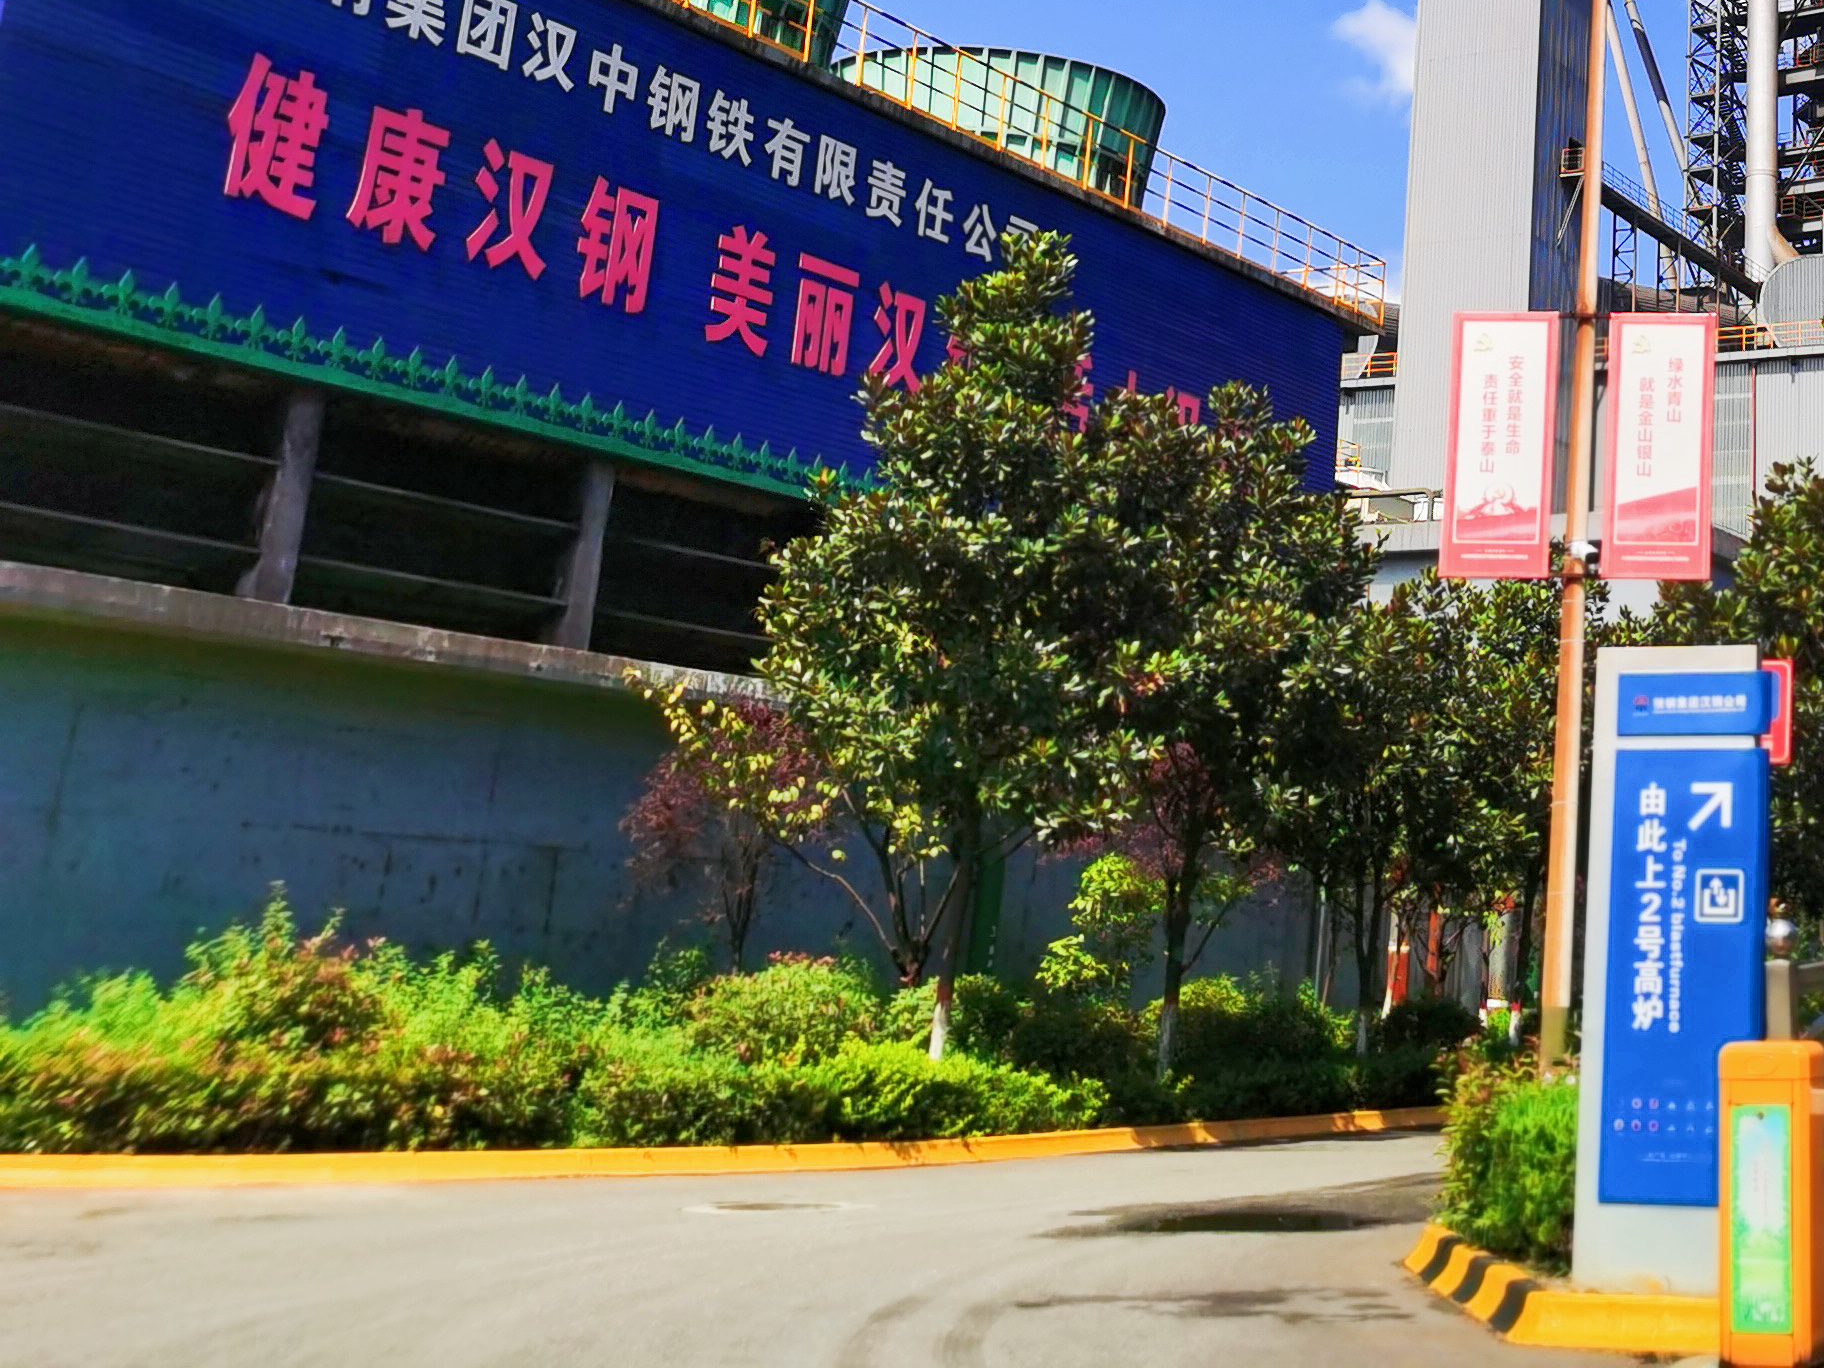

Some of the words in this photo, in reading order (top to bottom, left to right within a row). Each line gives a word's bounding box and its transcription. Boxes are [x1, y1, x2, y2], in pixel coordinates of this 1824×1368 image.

[223, 52, 661, 314] 健康汉钢
[705, 225, 975, 392] 美丽汉
[1479, 374, 1498, 474] 责任重于泰山
[1505, 355, 1524, 455] 安全就是生命
[1636, 377, 1655, 477] 就是金山银山
[1666, 357, 1684, 424] 绿水青山
[1671, 864, 1687, 910] No.2
[1672, 838, 1687, 863] To
[1632, 781, 1667, 1031] 由此上2号高炉
